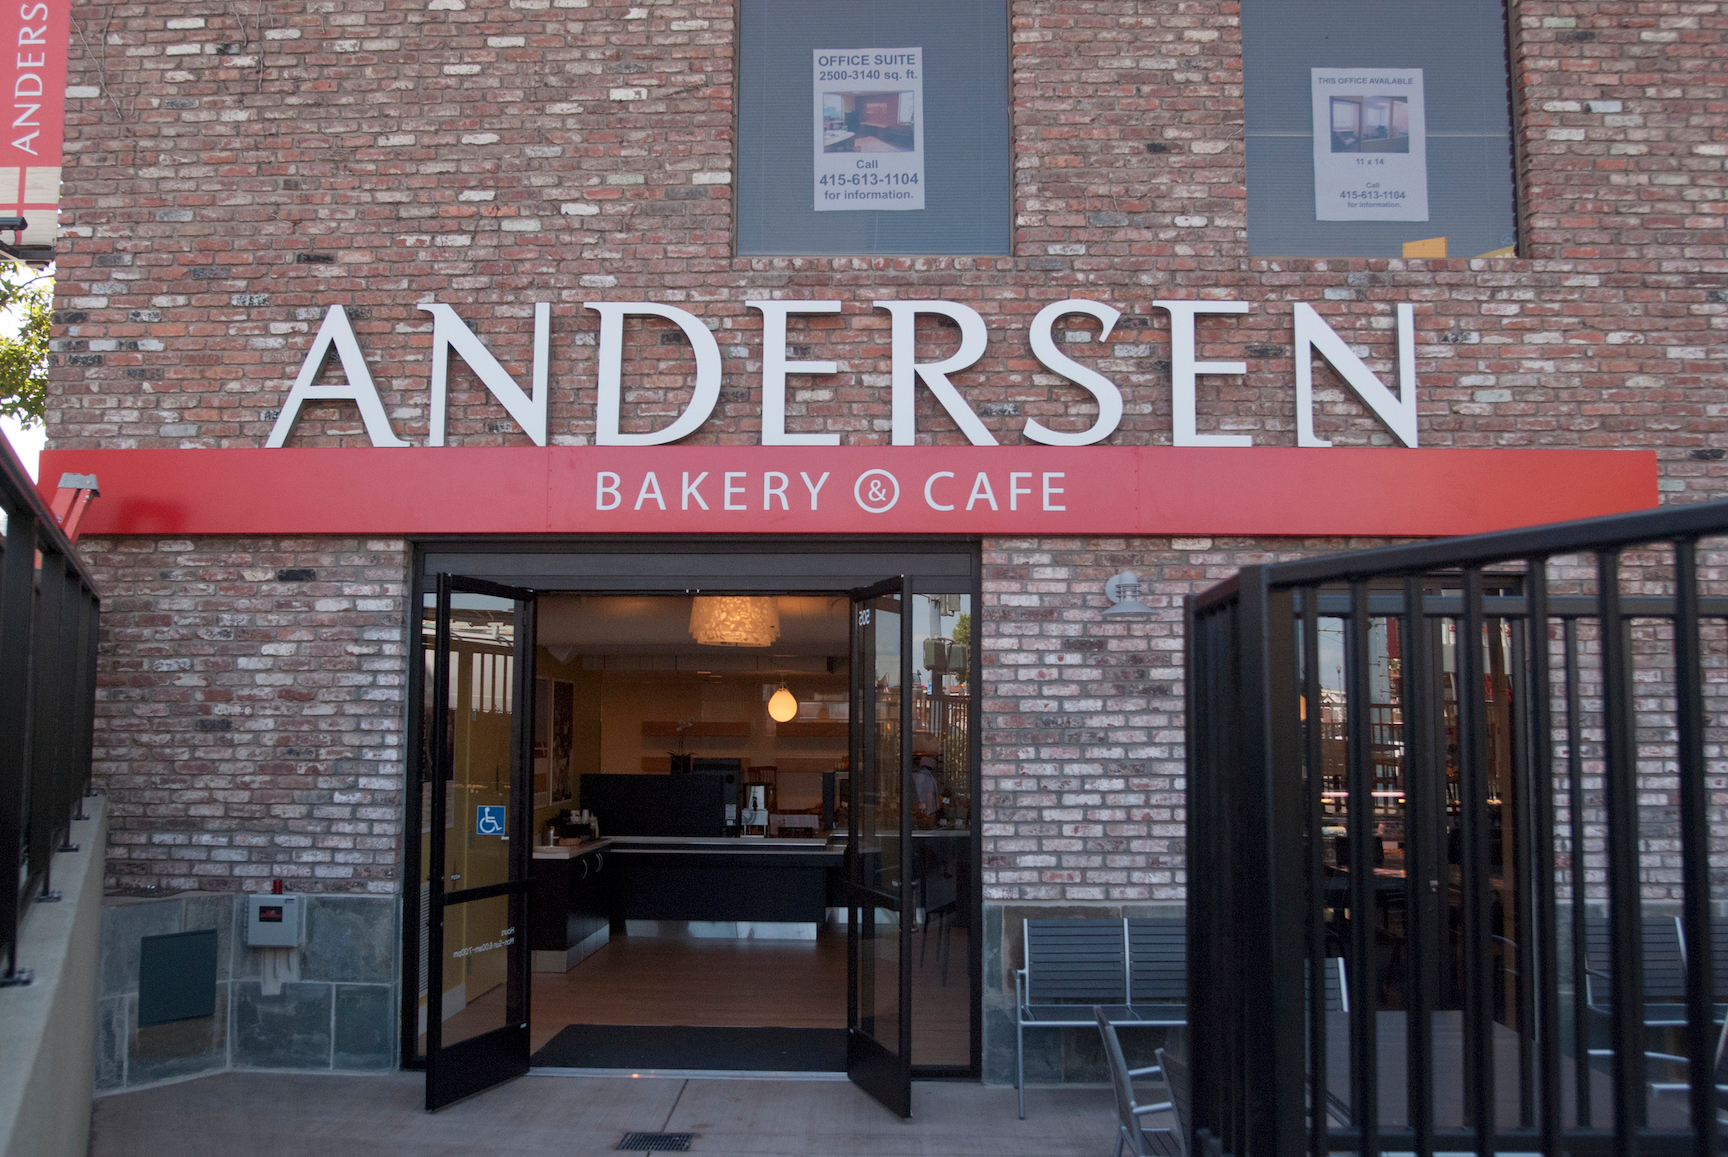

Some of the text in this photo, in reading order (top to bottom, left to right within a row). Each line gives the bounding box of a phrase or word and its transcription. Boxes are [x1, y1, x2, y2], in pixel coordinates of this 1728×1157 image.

[818, 54, 916, 67] OFFICE SUITE
[11, 3, 49, 156] ANDERS
[819, 69, 918, 81] 2500-3140 sq. ft.
[1318, 77, 1414, 85] THIS OFFICE AVAILABLE
[856, 159, 878, 169] Call
[819, 172, 919, 186] 415-613-1104
[824, 189, 914, 200] for information.
[1339, 191, 1406, 200] 415-613-1104
[265, 299, 1419, 449] ANDERSEN
[595, 471, 830, 511] BAKERY
[923, 471, 1067, 511] CAFE
